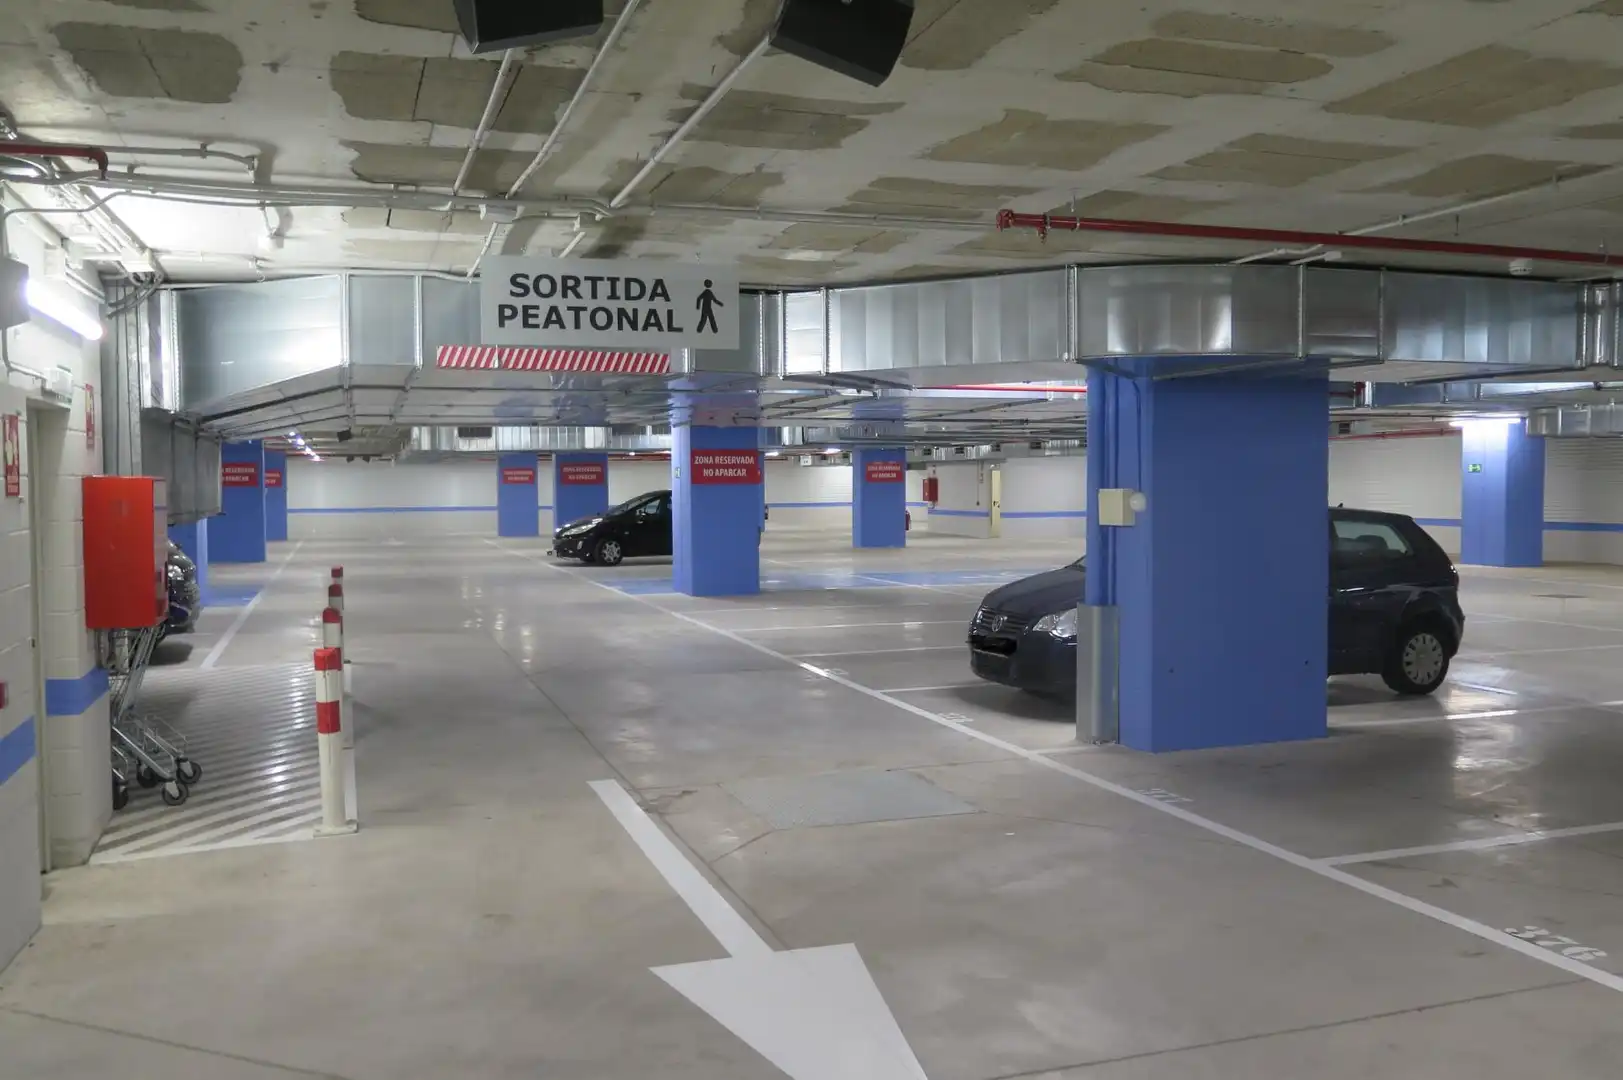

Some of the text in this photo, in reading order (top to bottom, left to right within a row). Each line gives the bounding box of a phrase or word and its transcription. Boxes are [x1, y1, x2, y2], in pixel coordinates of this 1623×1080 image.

[509, 273, 671, 302] SORTIDA
[498, 304, 684, 333] PEATONAL
[694, 456, 755, 465] ZONA RESERVADA
[703, 468, 747, 477] NO APARCAR
[1503, 926, 1607, 961] 376
